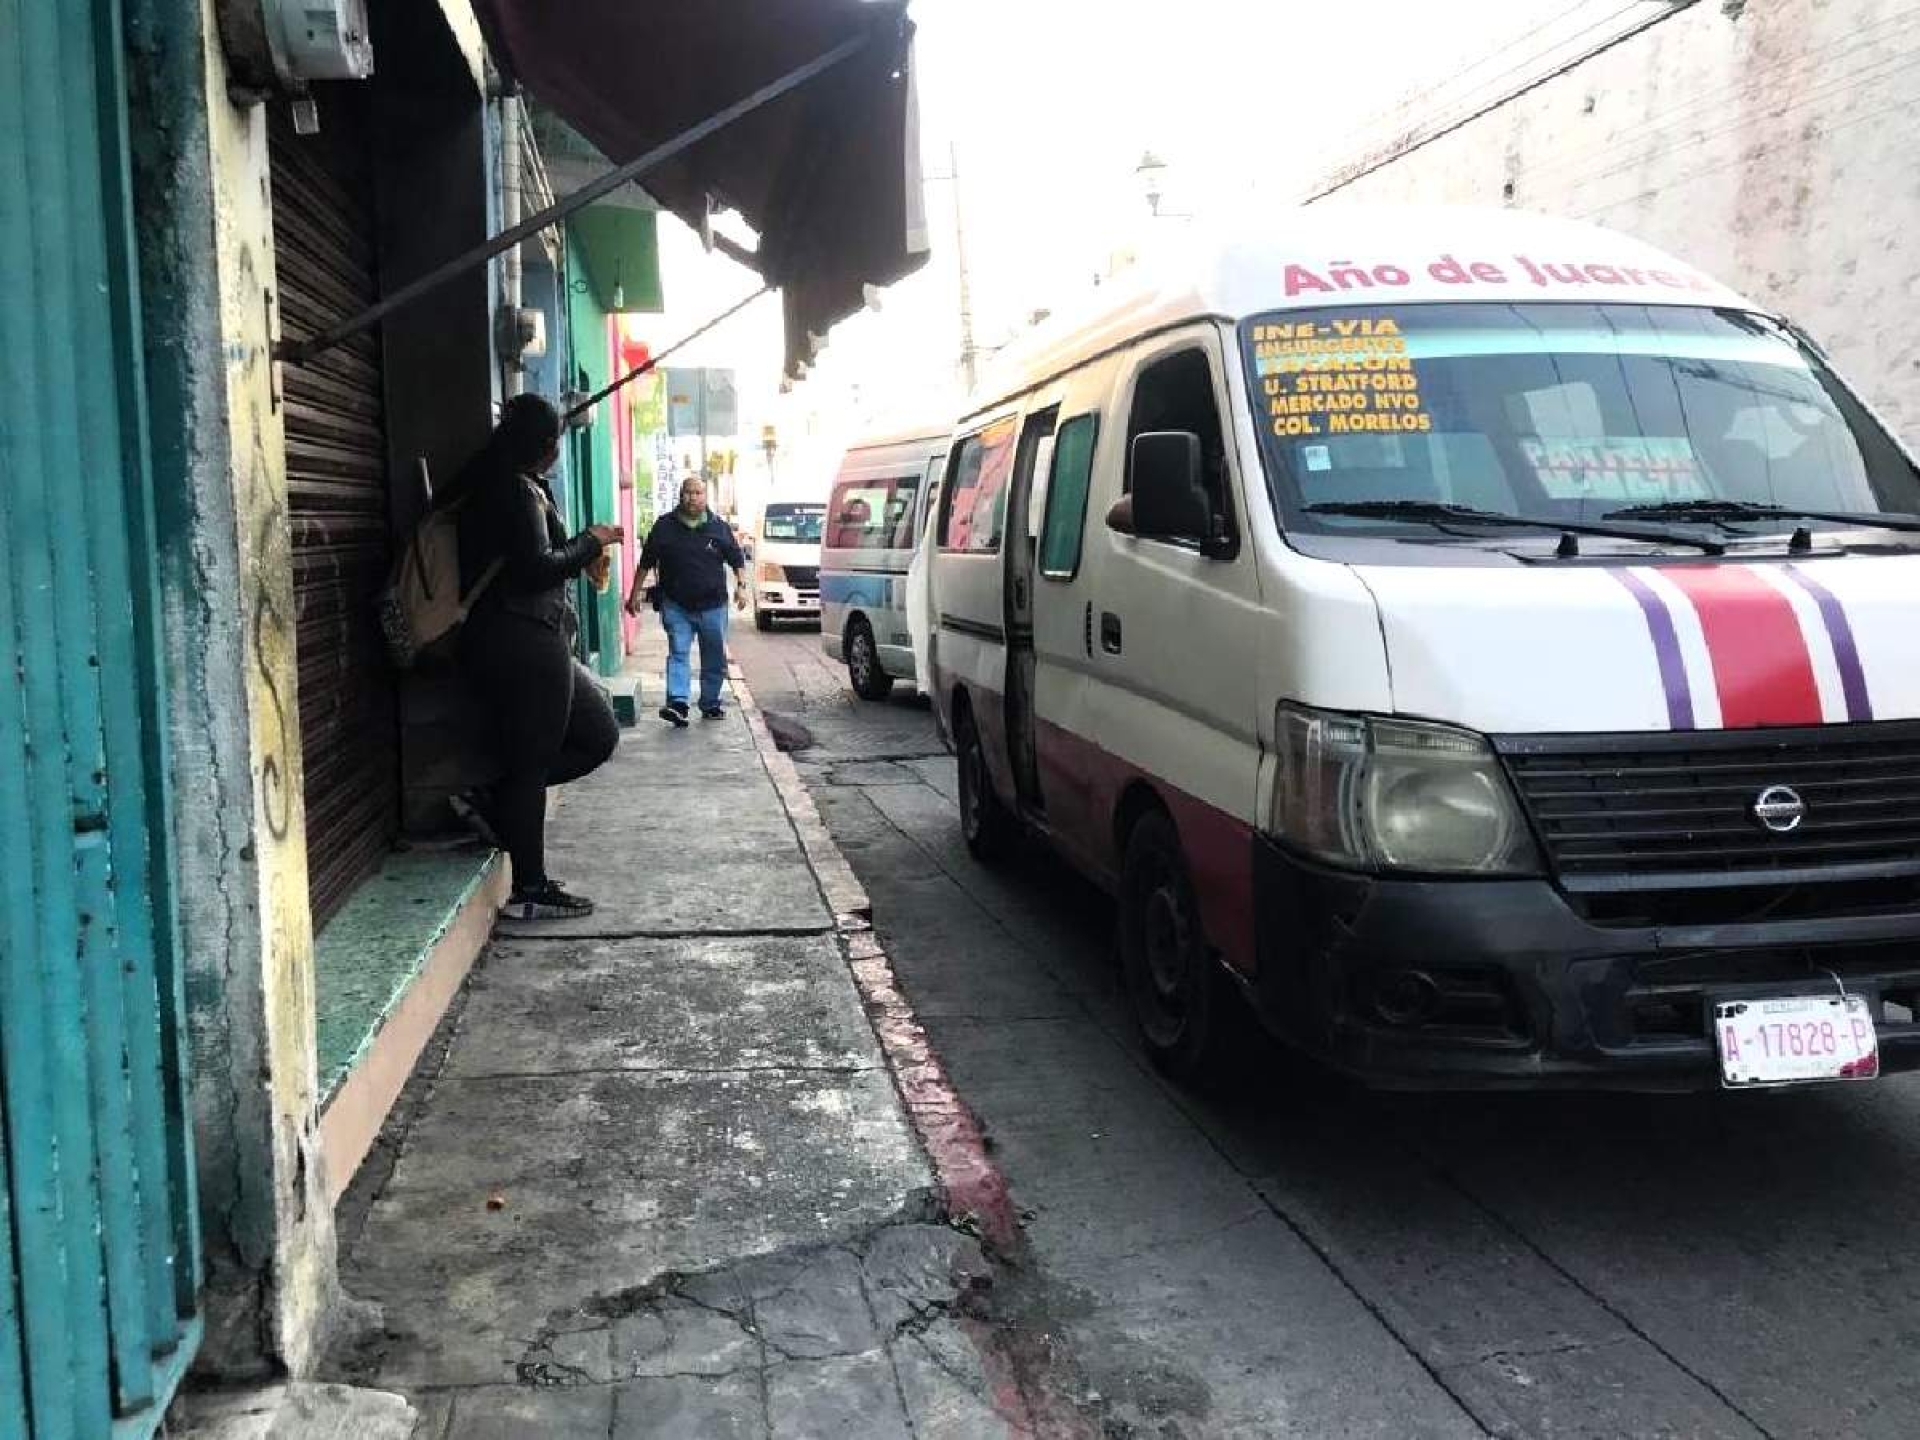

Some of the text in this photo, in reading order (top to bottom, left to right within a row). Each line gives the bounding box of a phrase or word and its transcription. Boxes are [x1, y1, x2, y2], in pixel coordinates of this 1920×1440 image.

[1284, 261, 1411, 297] Año
[1427, 254, 1508, 285] de
[1253, 319, 1399, 340] INE-VIA
[1264, 373, 1418, 396] U. STRATFORD
[1271, 392, 1368, 415] MERCADO
[1274, 412, 1432, 436] COL. MORELOS
[1725, 1018, 1867, 1062] A-17828-P
